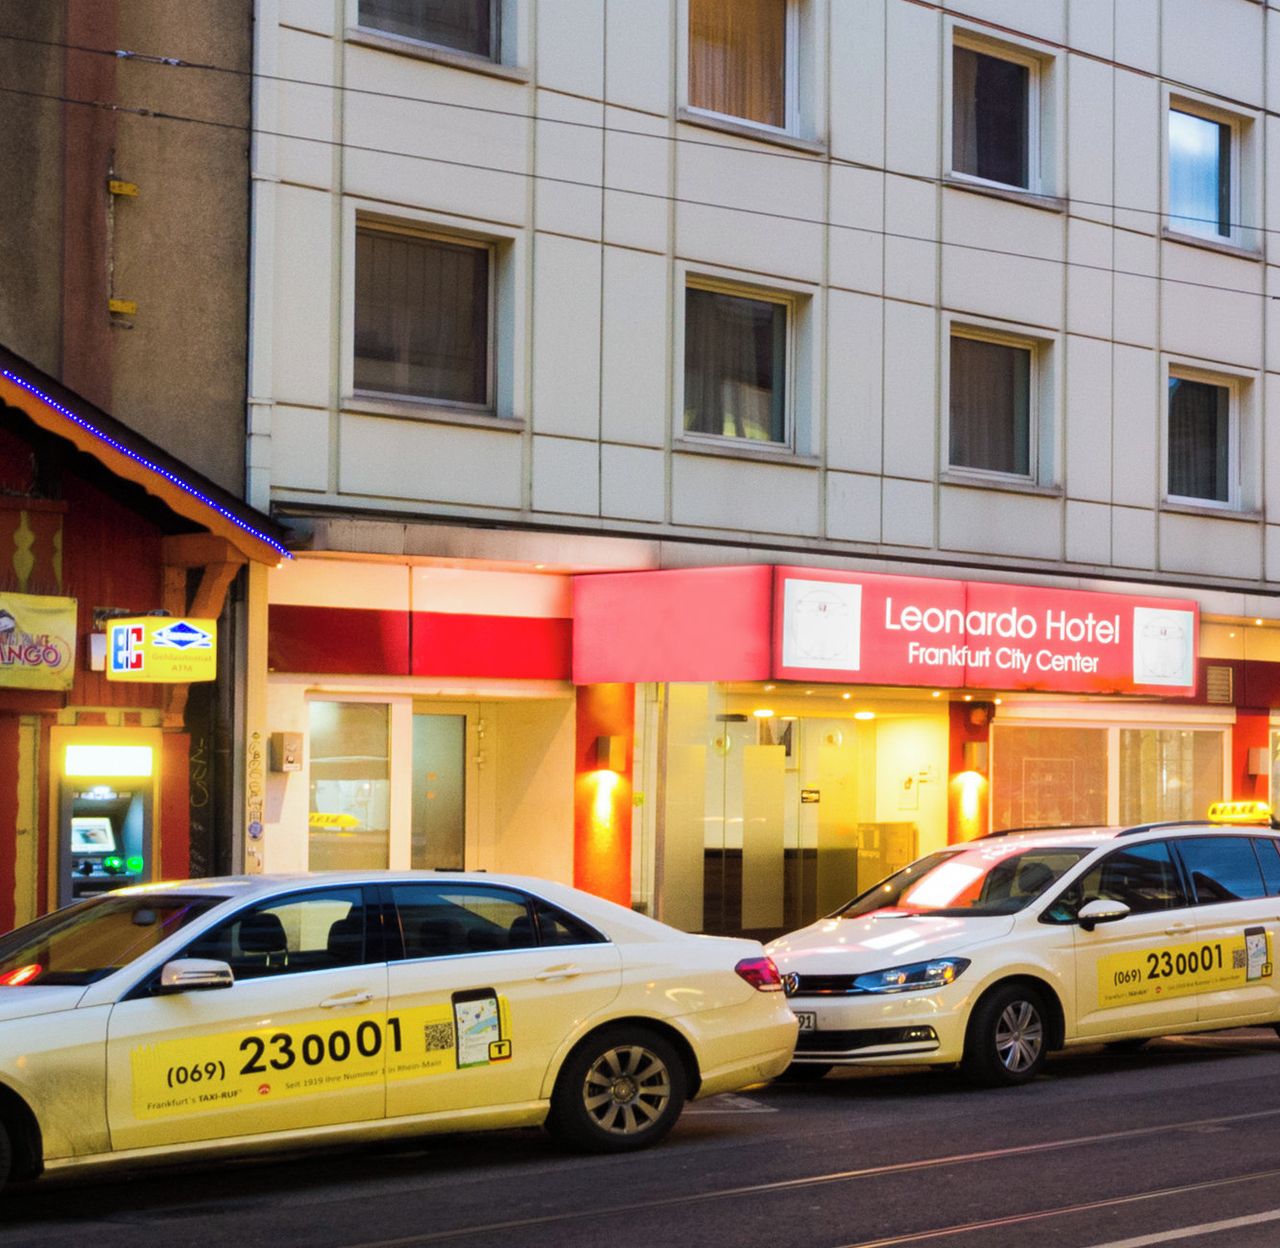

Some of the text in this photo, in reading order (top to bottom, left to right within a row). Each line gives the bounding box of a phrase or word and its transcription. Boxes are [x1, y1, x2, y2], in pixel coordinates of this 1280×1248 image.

[885, 597, 1120, 645] Leonardo Hotel
[171, 664, 193, 673] ATM
[908, 641, 1099, 674] Frankfurt City Center
[1114, 968, 1142, 987] (069)
[1147, 944, 1223, 980] 230001
[796, 1014, 812, 1029] 91
[239, 1017, 402, 1076] 230001
[167, 1060, 226, 1088] (069)
[285, 1079, 301, 1090] Seit
[303, 1076, 324, 1088] 1919
[343, 1070, 378, 1081] Nummer
[397, 1059, 442, 1073] Rhein-Main
